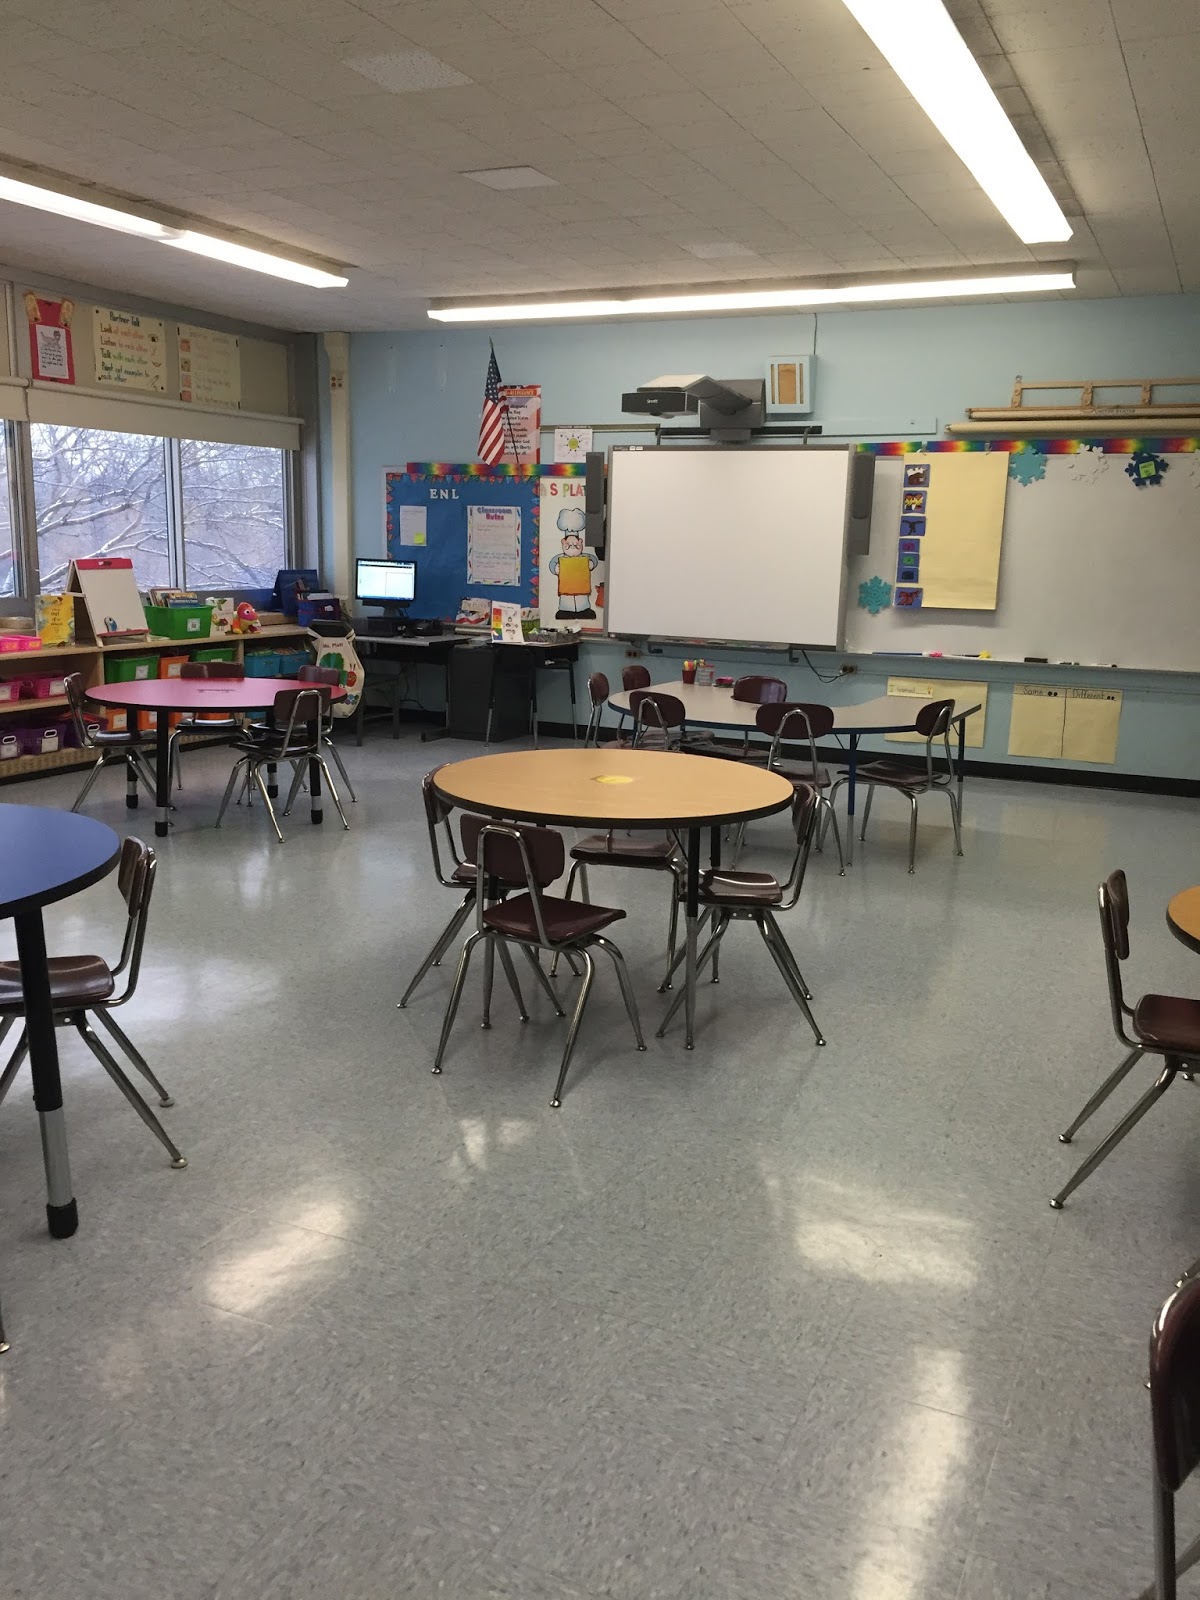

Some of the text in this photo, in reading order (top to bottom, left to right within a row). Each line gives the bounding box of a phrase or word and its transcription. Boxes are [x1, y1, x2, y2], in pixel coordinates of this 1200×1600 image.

[110, 311, 140, 327] Partner Talk
[430, 488, 459, 499] ENL
[477, 506, 512, 514] Classroom
[486, 513, 504, 521] Rules
[1023, 684, 1105, 700] Same Different
